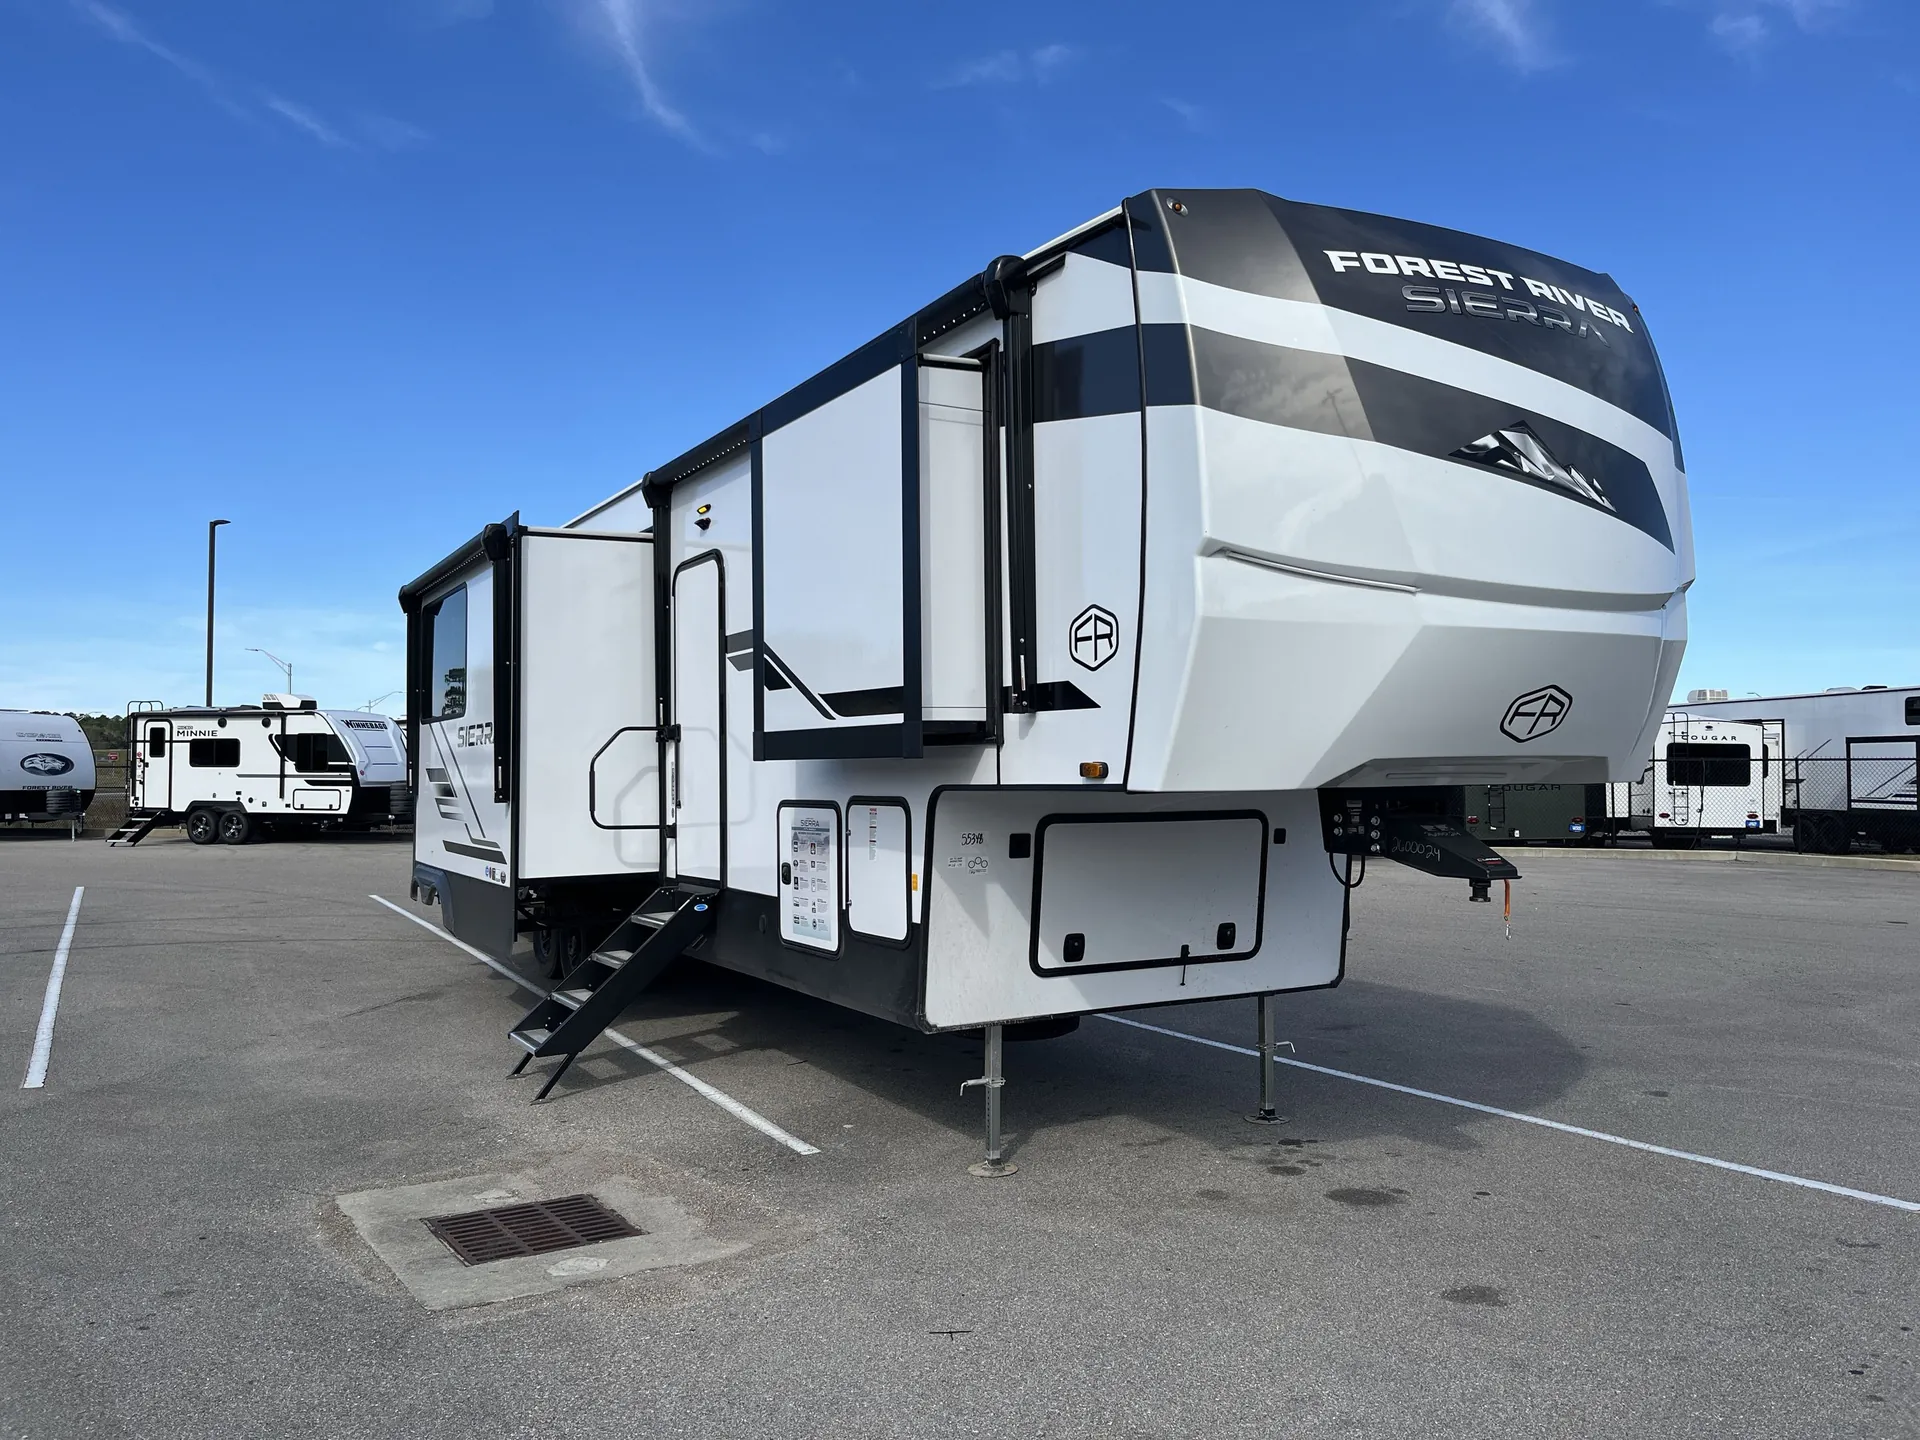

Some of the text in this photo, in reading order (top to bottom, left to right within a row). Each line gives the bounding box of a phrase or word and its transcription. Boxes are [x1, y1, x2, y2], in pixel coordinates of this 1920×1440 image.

[1323, 250, 1634, 333] FOREST RIVER
[1402, 285, 1611, 347] SIERRA
[176, 729, 218, 737] MINNIE
[341, 719, 388, 731] WINNEBAGO
[457, 721, 494, 748] SIERR
